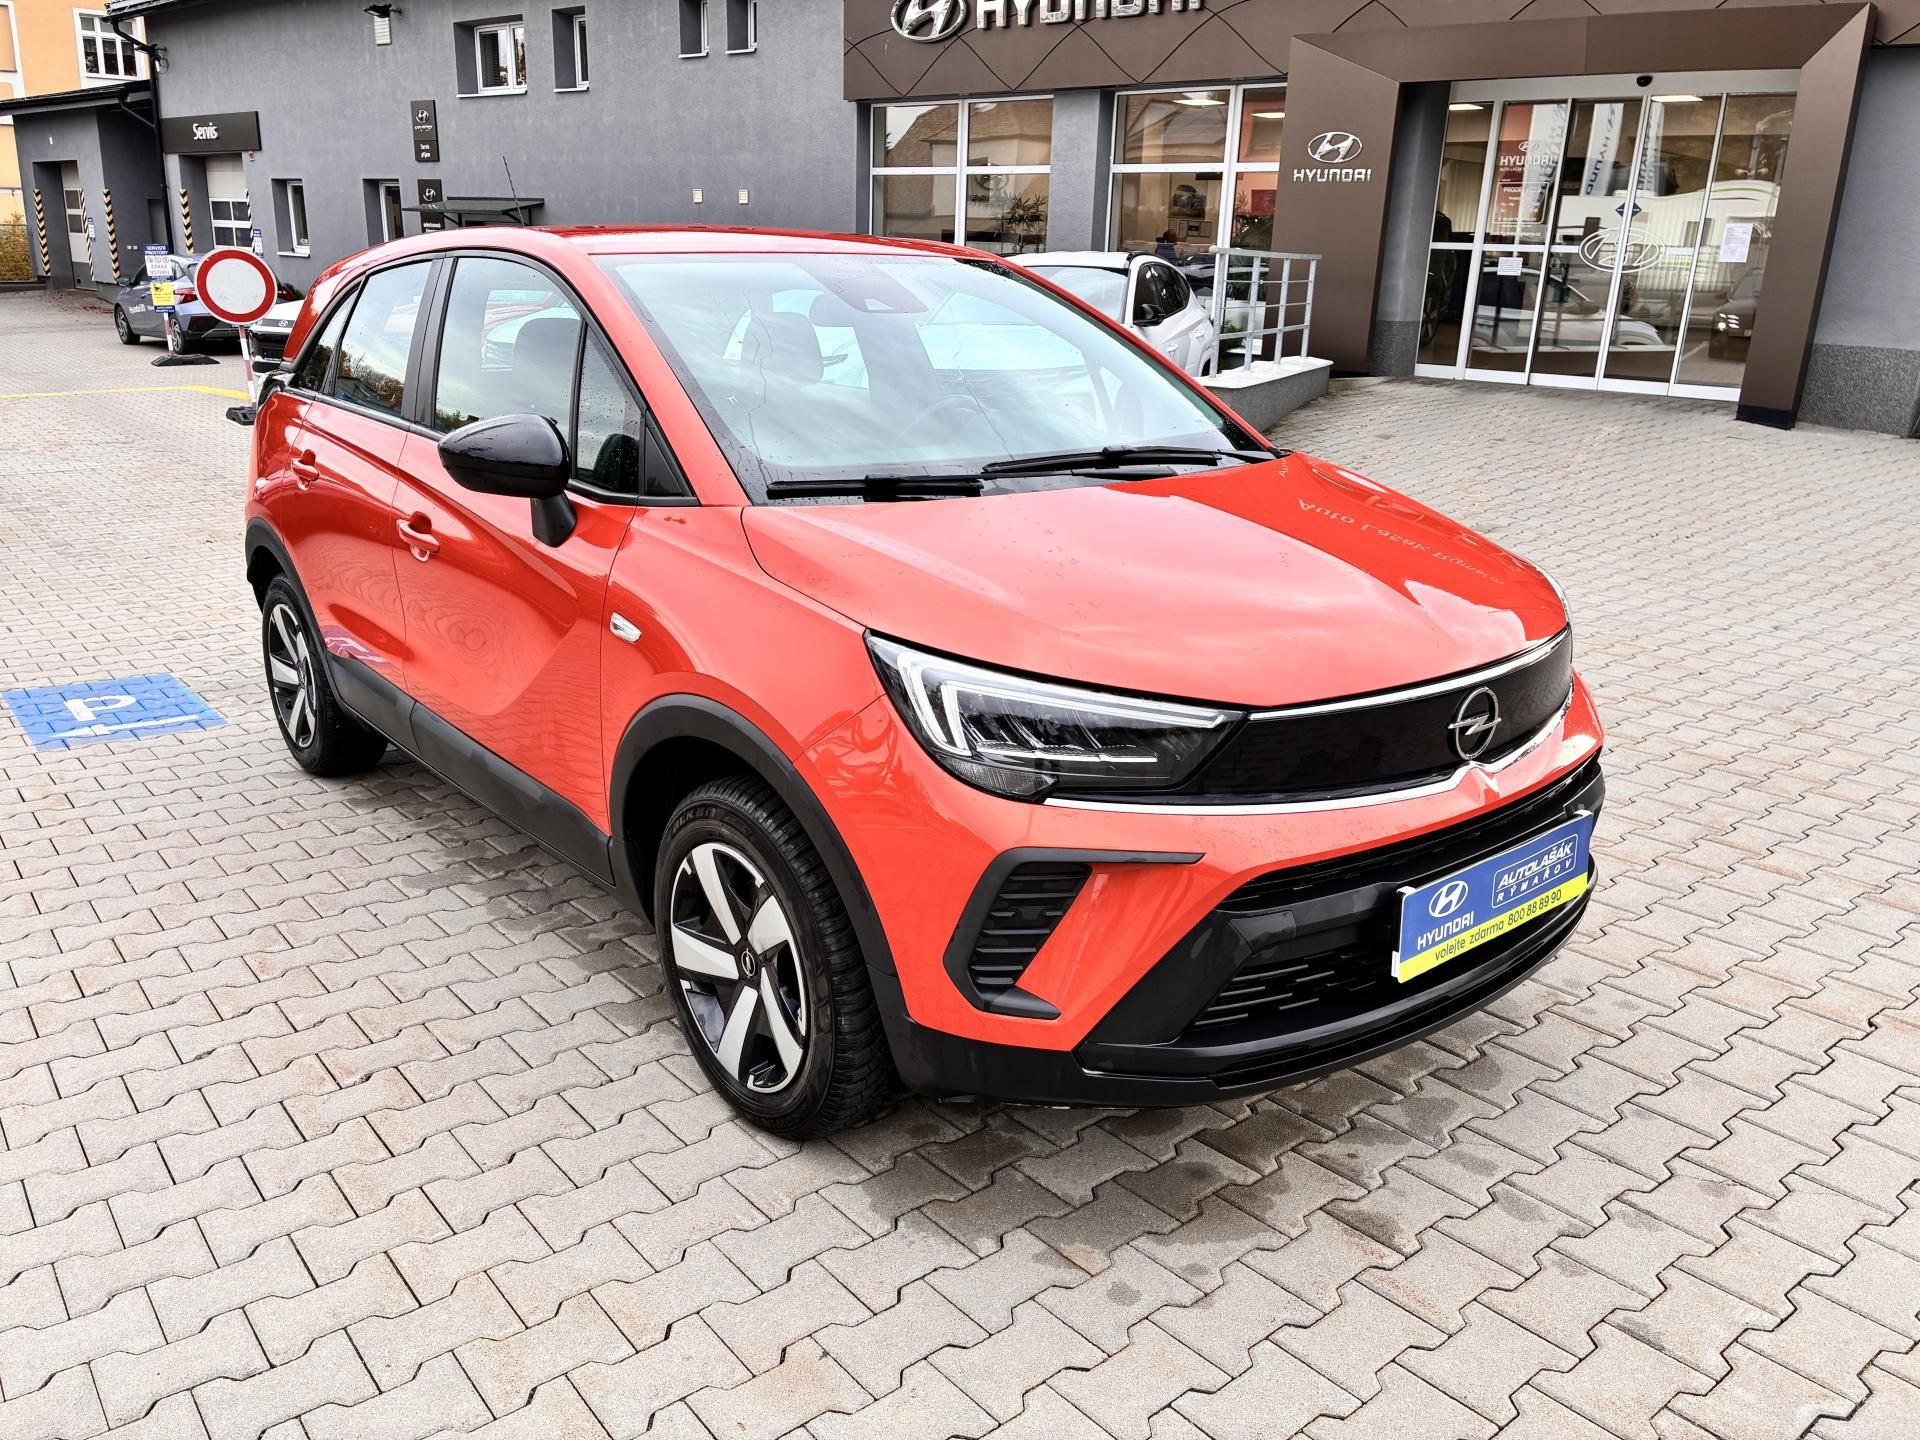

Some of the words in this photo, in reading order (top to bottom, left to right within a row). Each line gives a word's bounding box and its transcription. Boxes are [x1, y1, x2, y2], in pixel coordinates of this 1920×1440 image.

[976, 0, 1202, 29] HYUND
[192, 122, 219, 140] Servis
[1293, 168, 1372, 182] HYUNDAI
[64, 695, 137, 721] P
[1496, 858, 1572, 903] RÝMAŘOV
[1497, 842, 1574, 887] AUTOLAŠÁK
[1417, 911, 1474, 951] HYUNDAI
[1435, 941, 1466, 961] volejte
[1469, 920, 1505, 945] zdarma
[1507, 909, 1525, 927] 800
[1526, 902, 1538, 917] 88
[1538, 896, 1550, 910] 89
[1551, 889, 1562, 906] 90
